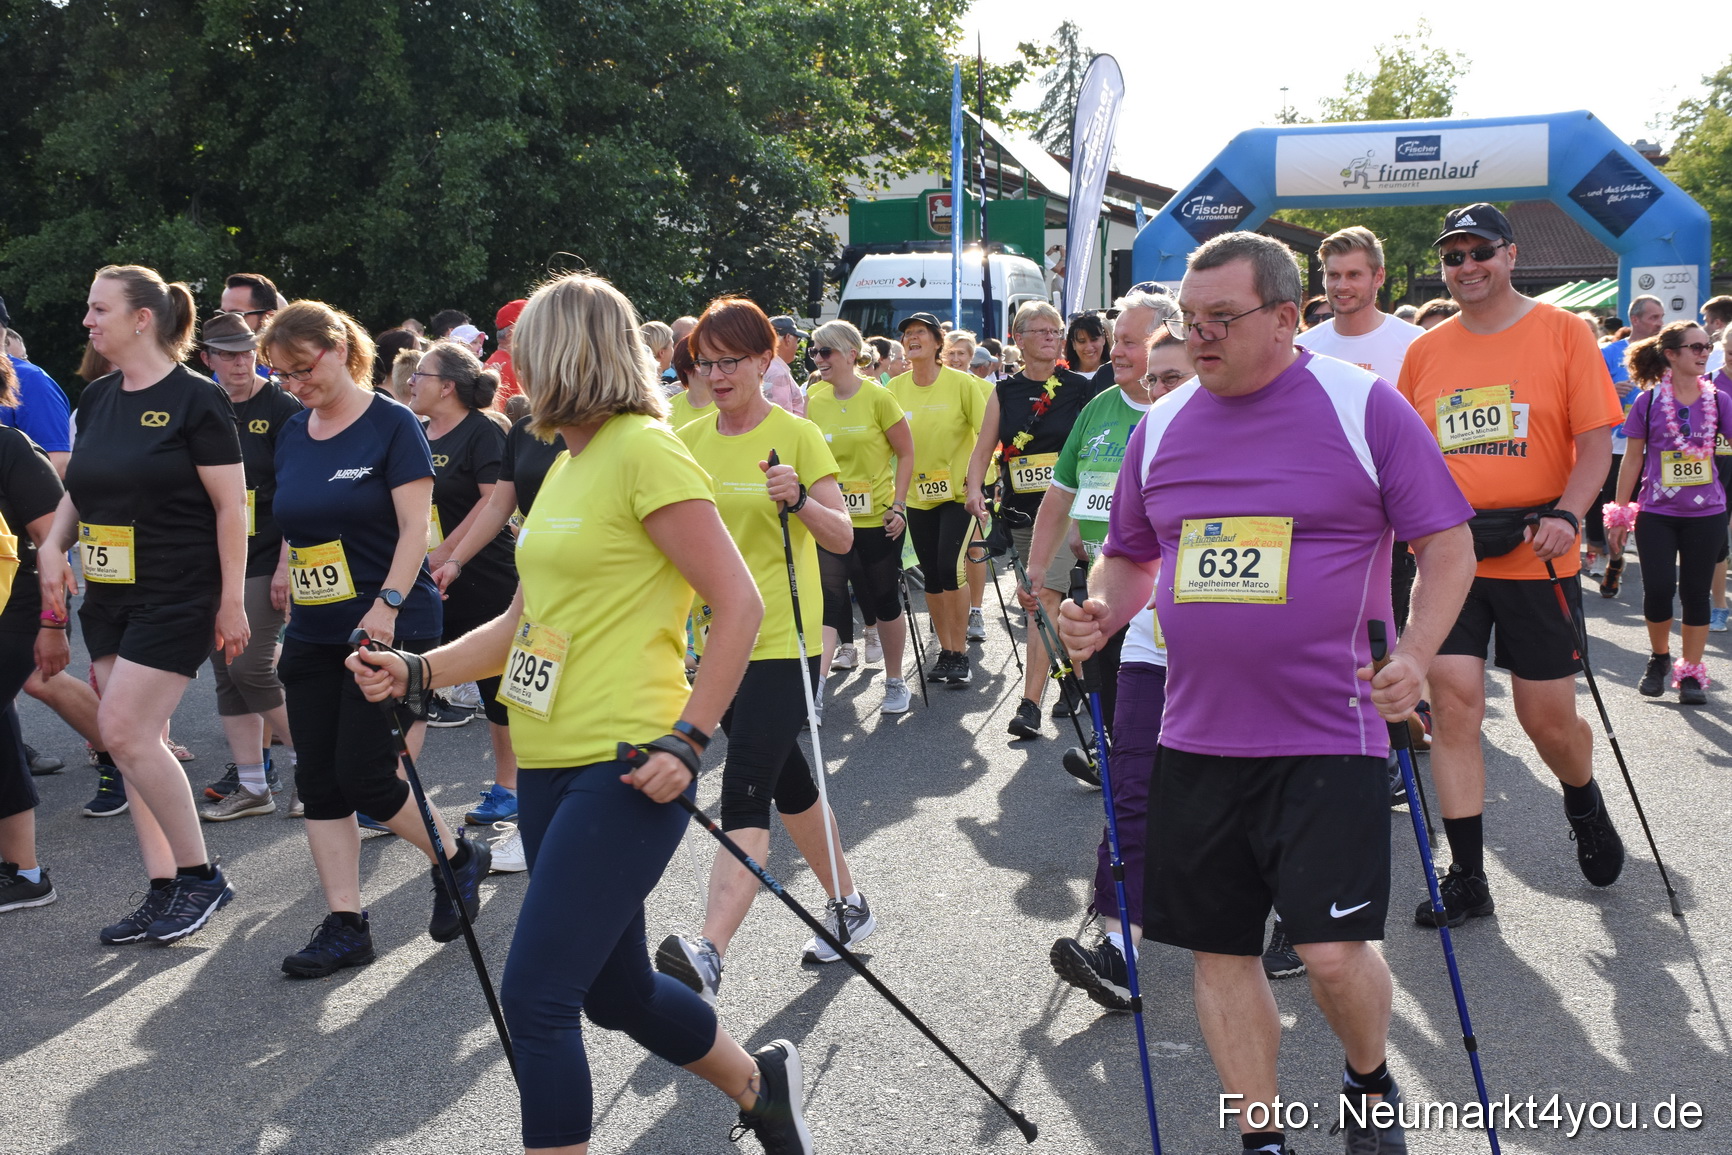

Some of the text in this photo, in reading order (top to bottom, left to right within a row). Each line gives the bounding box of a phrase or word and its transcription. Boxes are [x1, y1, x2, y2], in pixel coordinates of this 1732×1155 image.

[1086, 77, 1110, 169] Fischer
[1404, 144, 1438, 153] Fischer
[1378, 160, 1480, 181] firmenlauf
[1378, 181, 1420, 189] neumarkt
[1604, 185, 1620, 194] das
[1191, 203, 1243, 215] Fischer
[855, 277, 896, 288] abavent
[1445, 405, 1501, 433] 1160
[1475, 426, 1499, 434] Michael
[1016, 467, 1052, 483] 1958
[1673, 462, 1702, 477] 886
[918, 480, 948, 495] 1298
[1086, 494, 1113, 511] 906
[1195, 533, 1237, 543] firmenlauf
[86, 545, 109, 567] 75
[1198, 548, 1261, 578] 632
[292, 565, 339, 589] 1419
[1188, 580, 1270, 589] Hegelheimer Marco
[508, 649, 553, 692] 1295
[521, 687, 532, 698] Eva
